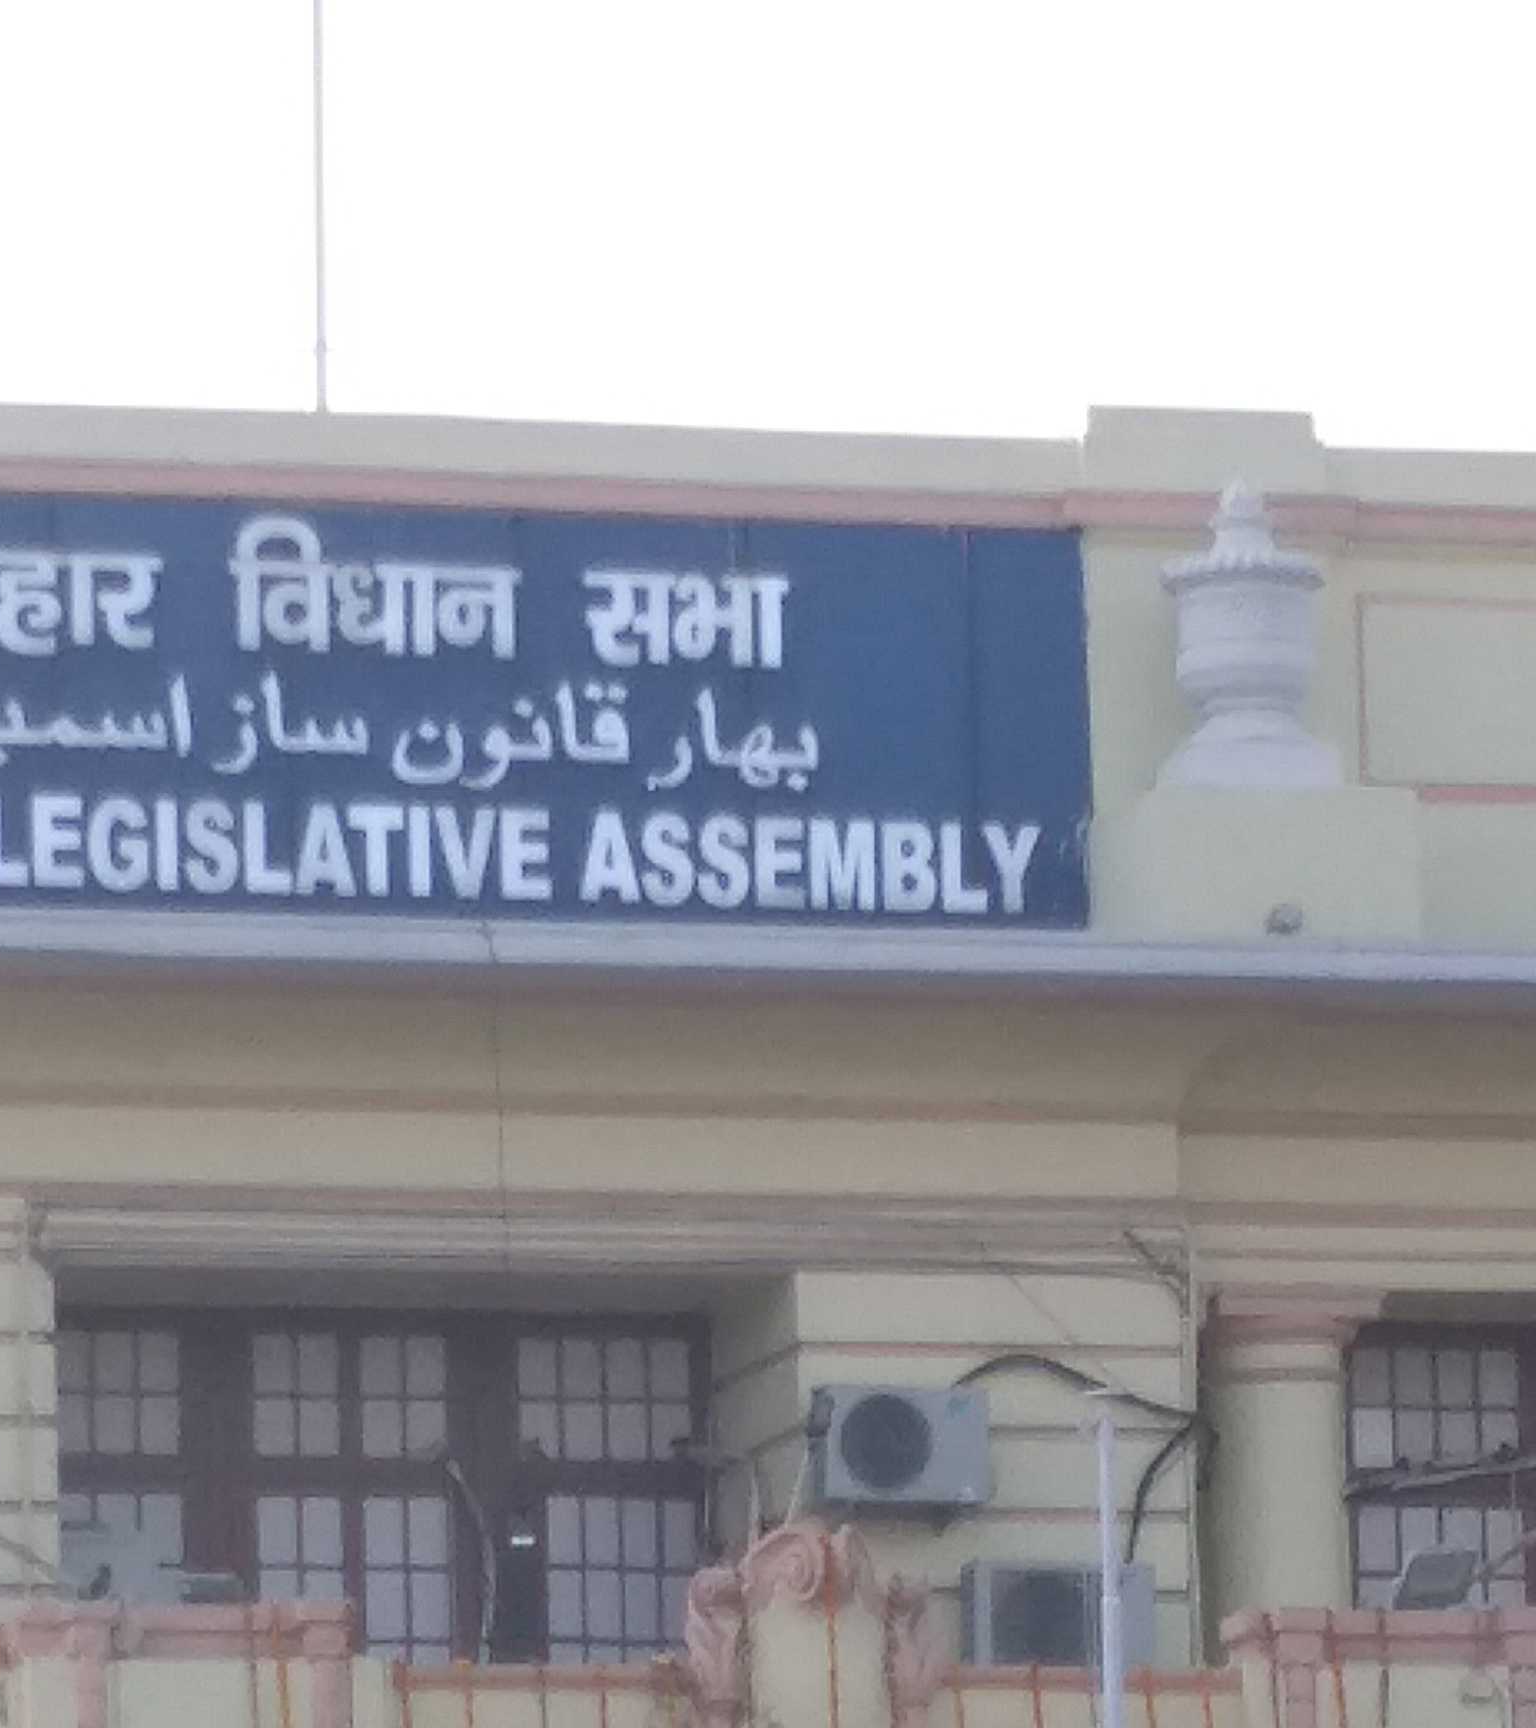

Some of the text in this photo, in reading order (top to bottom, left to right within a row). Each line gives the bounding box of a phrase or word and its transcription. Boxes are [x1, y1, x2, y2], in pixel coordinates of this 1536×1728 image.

[228, 516, 522, 660] विधान
[582, 563, 790, 670] सभा
[211, 669, 369, 775] ساز
[391, 678, 630, 790] قانون
[578, 810, 1044, 916] ASSEMBLY
